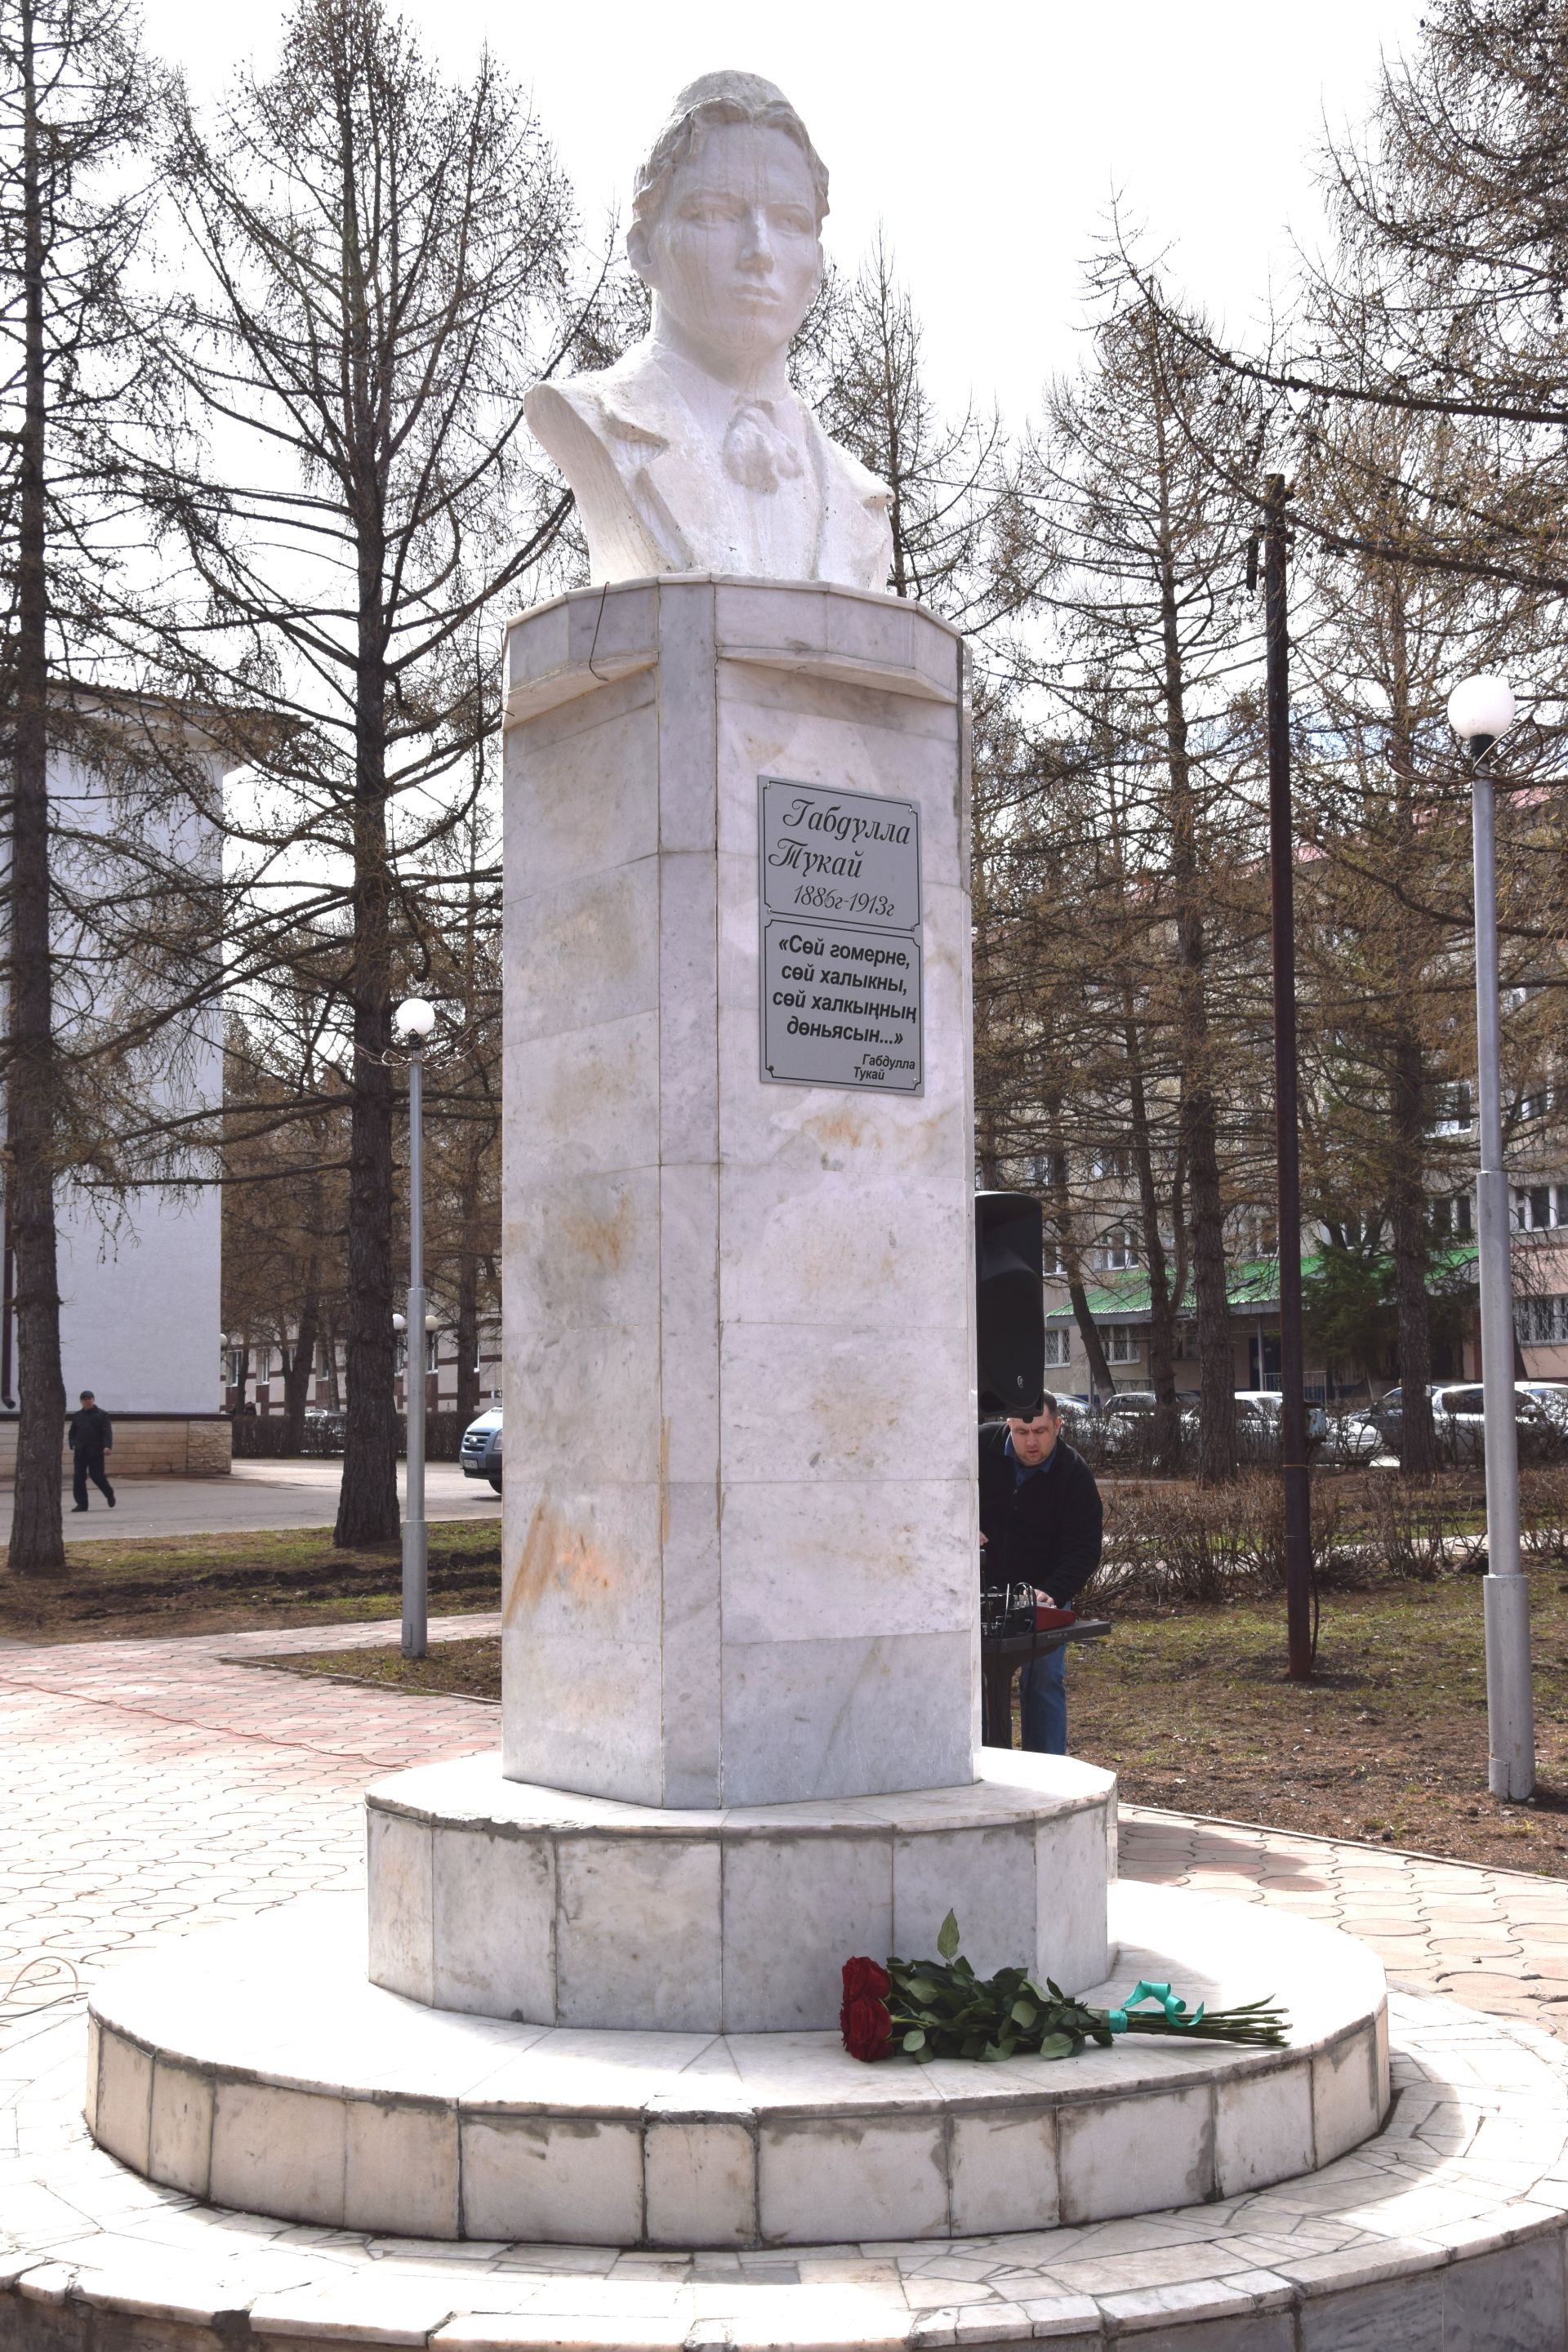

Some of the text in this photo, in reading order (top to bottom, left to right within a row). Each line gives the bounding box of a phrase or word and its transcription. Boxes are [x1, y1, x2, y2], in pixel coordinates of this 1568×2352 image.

[782, 799, 911, 844] Габдулла
[768, 838, 864, 878] Тукай
[829, 944, 910, 970] гомерне,
[781, 963, 907, 996] сөй халыкны,
[773, 989, 807, 1008] сөй
[853, 1066, 885, 1081] Тукай
[862, 1054, 915, 1071] Габдулла
